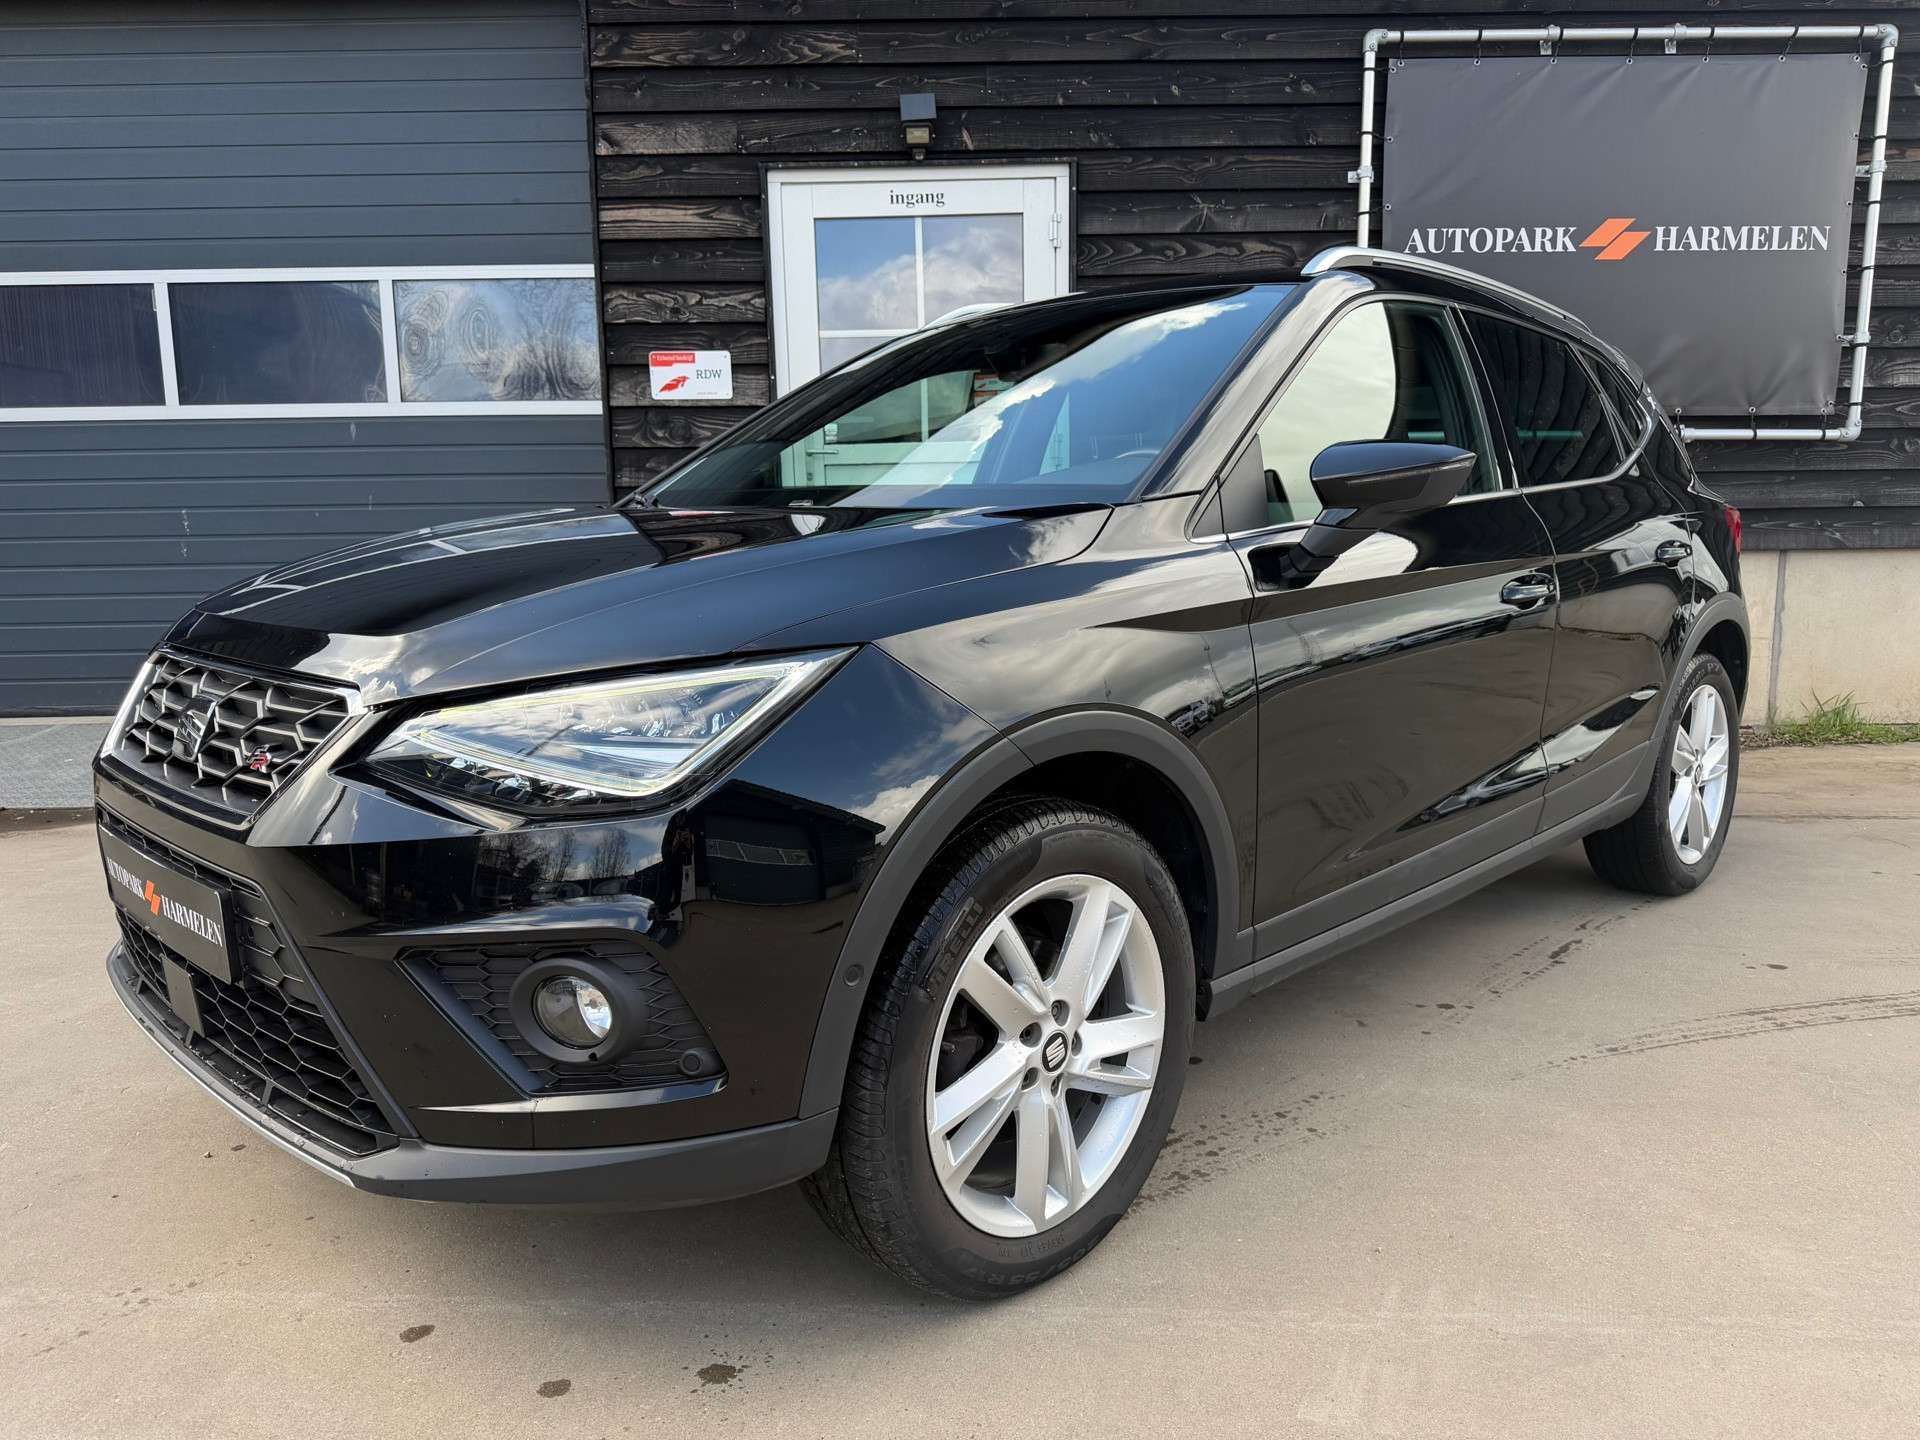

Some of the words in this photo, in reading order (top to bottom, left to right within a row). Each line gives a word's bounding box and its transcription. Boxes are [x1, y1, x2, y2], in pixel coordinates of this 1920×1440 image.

[889, 189, 945, 208] ingang
[1403, 226, 1577, 254] AUTOPARK
[1653, 225, 1831, 252] HARMELEN
[696, 369, 722, 380] RDW
[106, 856, 146, 901] AUTOPARK
[161, 894, 223, 948] HARMELEN
